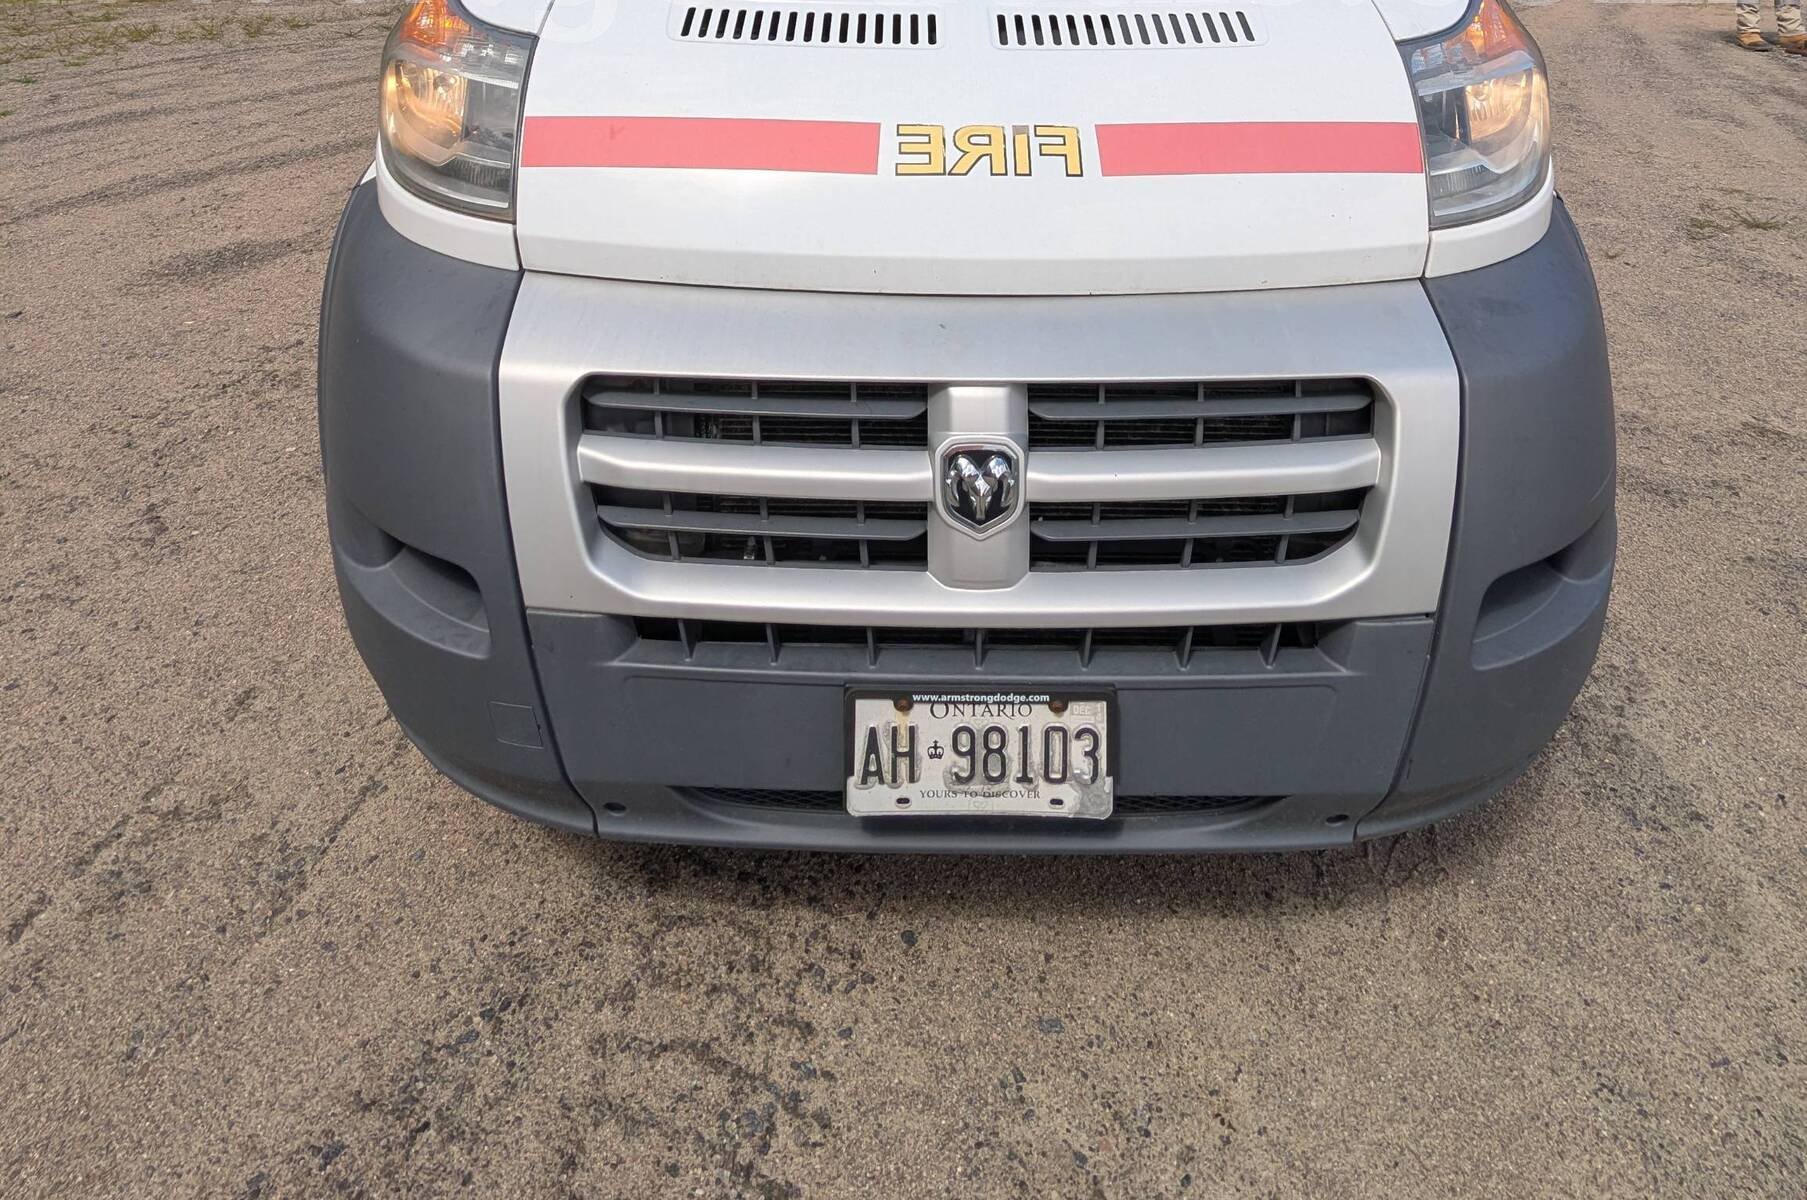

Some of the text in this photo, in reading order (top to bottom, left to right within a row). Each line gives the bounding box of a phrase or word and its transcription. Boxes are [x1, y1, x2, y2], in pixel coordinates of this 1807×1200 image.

[912, 693, 1050, 704] www.armstrongdodge.com
[930, 702, 1033, 719] ONTARIO
[860, 725, 1100, 785] AH 98103
[919, 790, 1041, 799] YOURS TO DISCOVER
